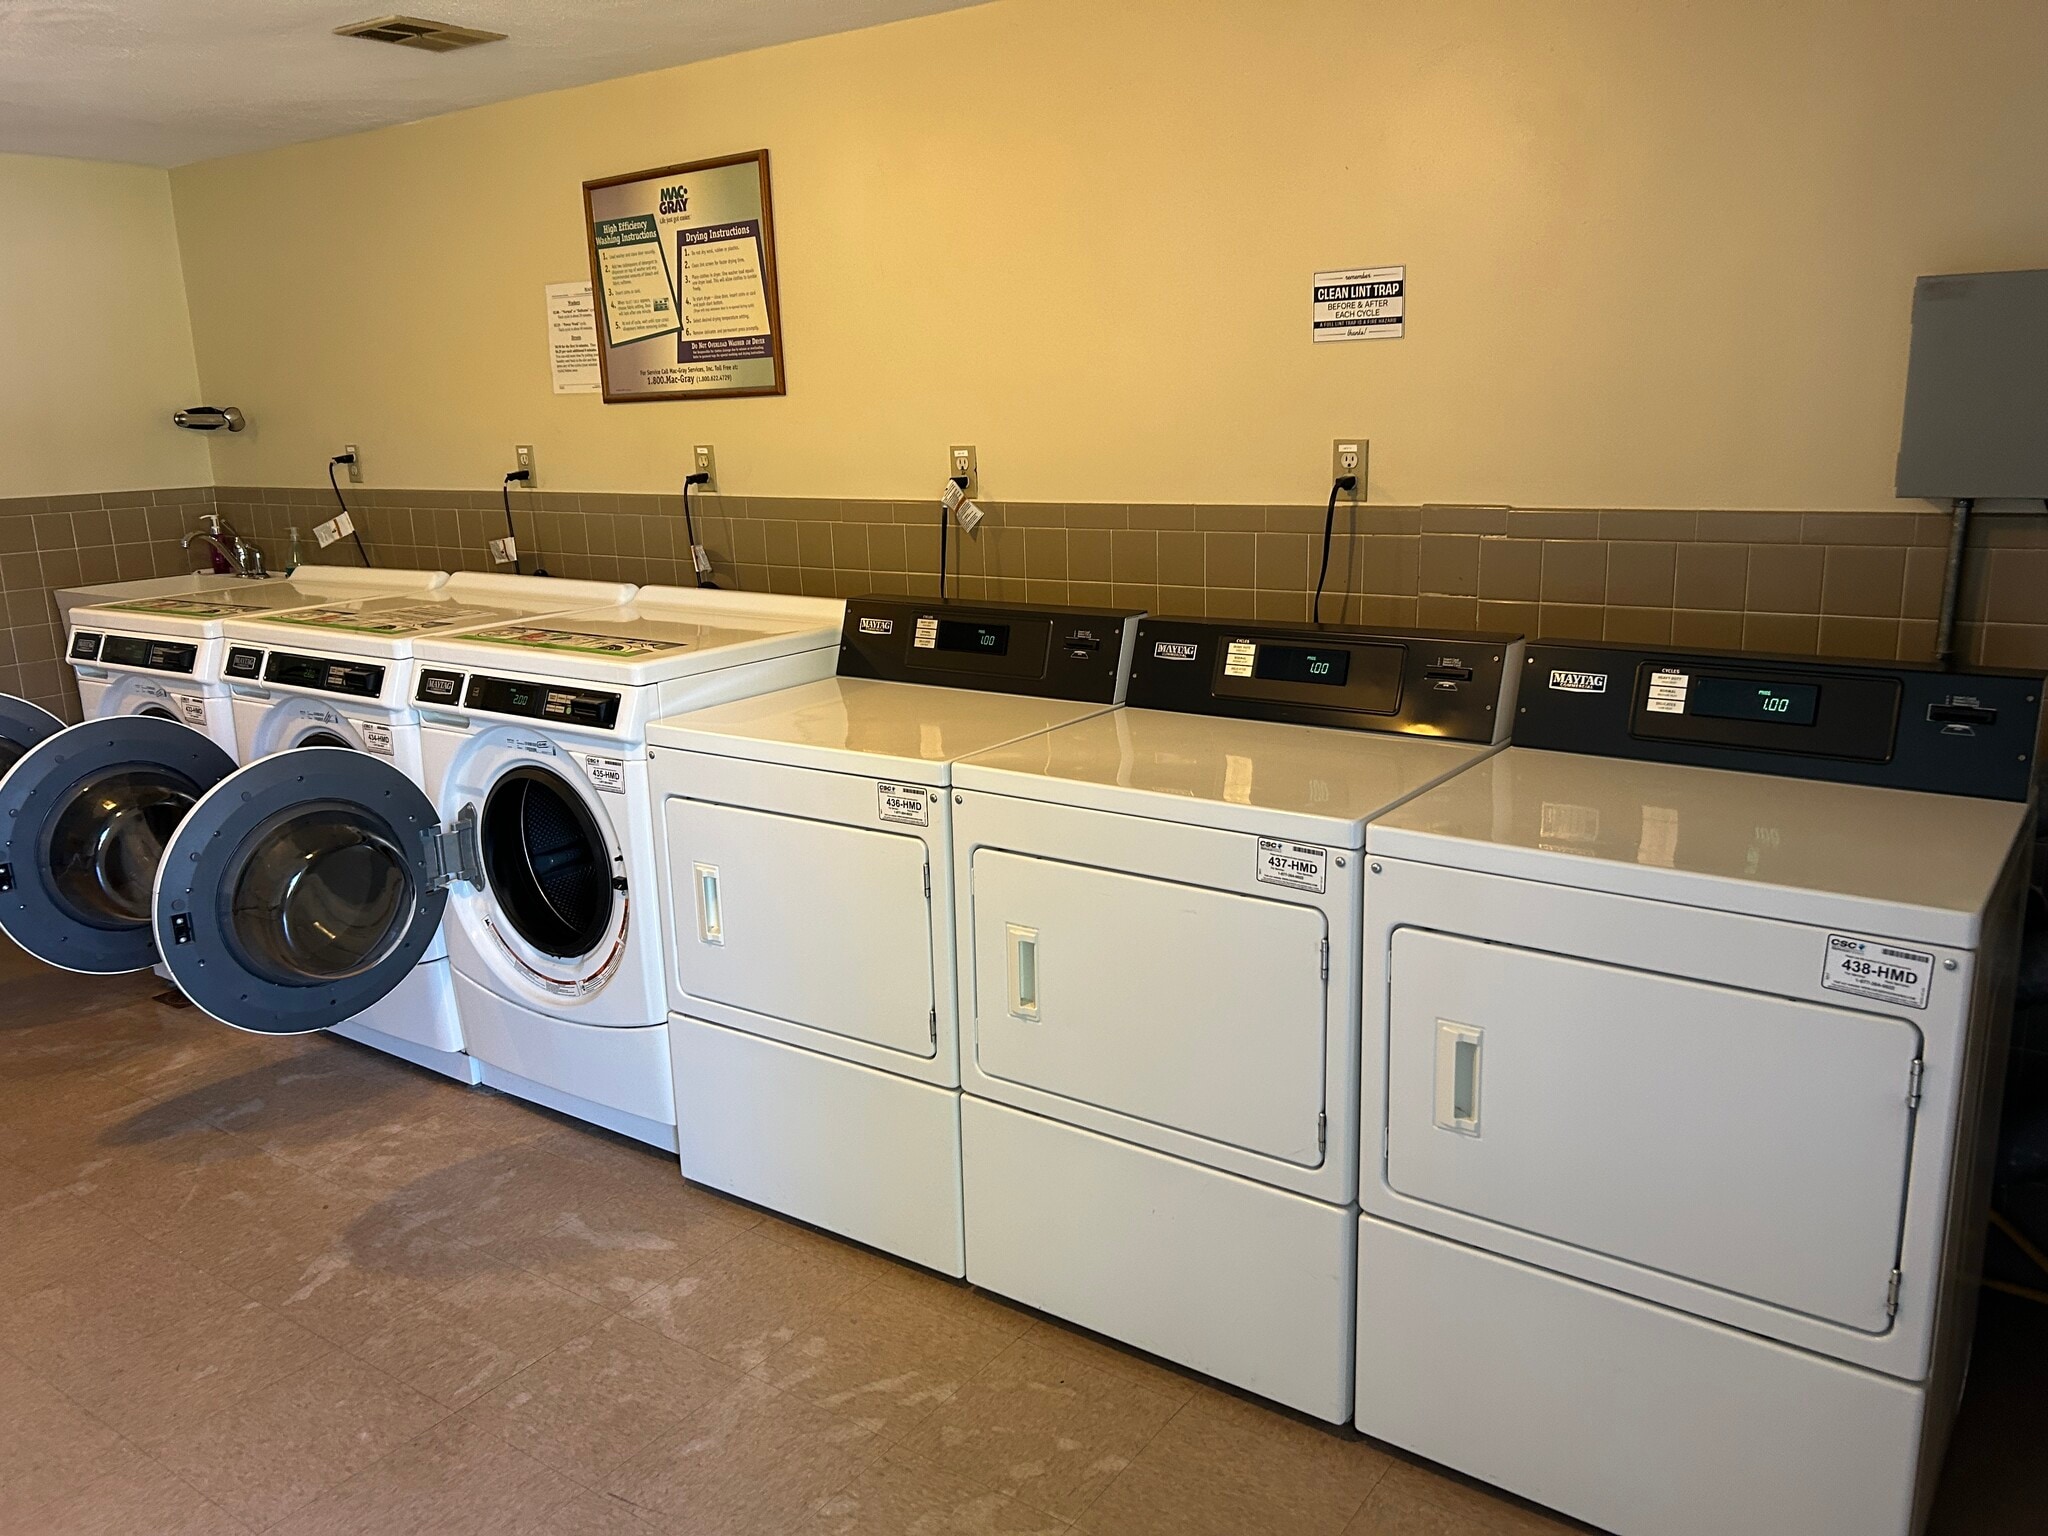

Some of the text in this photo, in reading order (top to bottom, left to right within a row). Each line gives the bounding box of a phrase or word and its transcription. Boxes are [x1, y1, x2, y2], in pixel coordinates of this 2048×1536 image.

[659, 198, 688, 215] GRAY
[603, 221, 648, 235] High Efficiency
[596, 230, 657, 245] Washing Instructions
[685, 226, 750, 243] Drying Instructions
[1345, 272, 1371, 280] remember
[1318, 283, 1400, 300] CLEAN LINT TRAP
[1328, 302, 1355, 310] BEFORE
[1365, 300, 1388, 308] AFTER
[1335, 309, 1380, 319] EACH CYCLE
[1347, 328, 1367, 336] thanks!
[647, 375, 694, 385] 1.800.Mac-Gray
[861, 620, 890, 629] MAYTAG
[1158, 644, 1194, 654] MAYTAG
[1553, 673, 1603, 686] MAYTAG
[513, 694, 528, 706] 2.00
[593, 769, 620, 780] 435-HMD
[886, 798, 921, 810] 436-HMD
[1268, 856, 1318, 874] 437-HMD
[1831, 939, 1857, 949] CSC
[1841, 959, 1918, 984] 438-HMD
